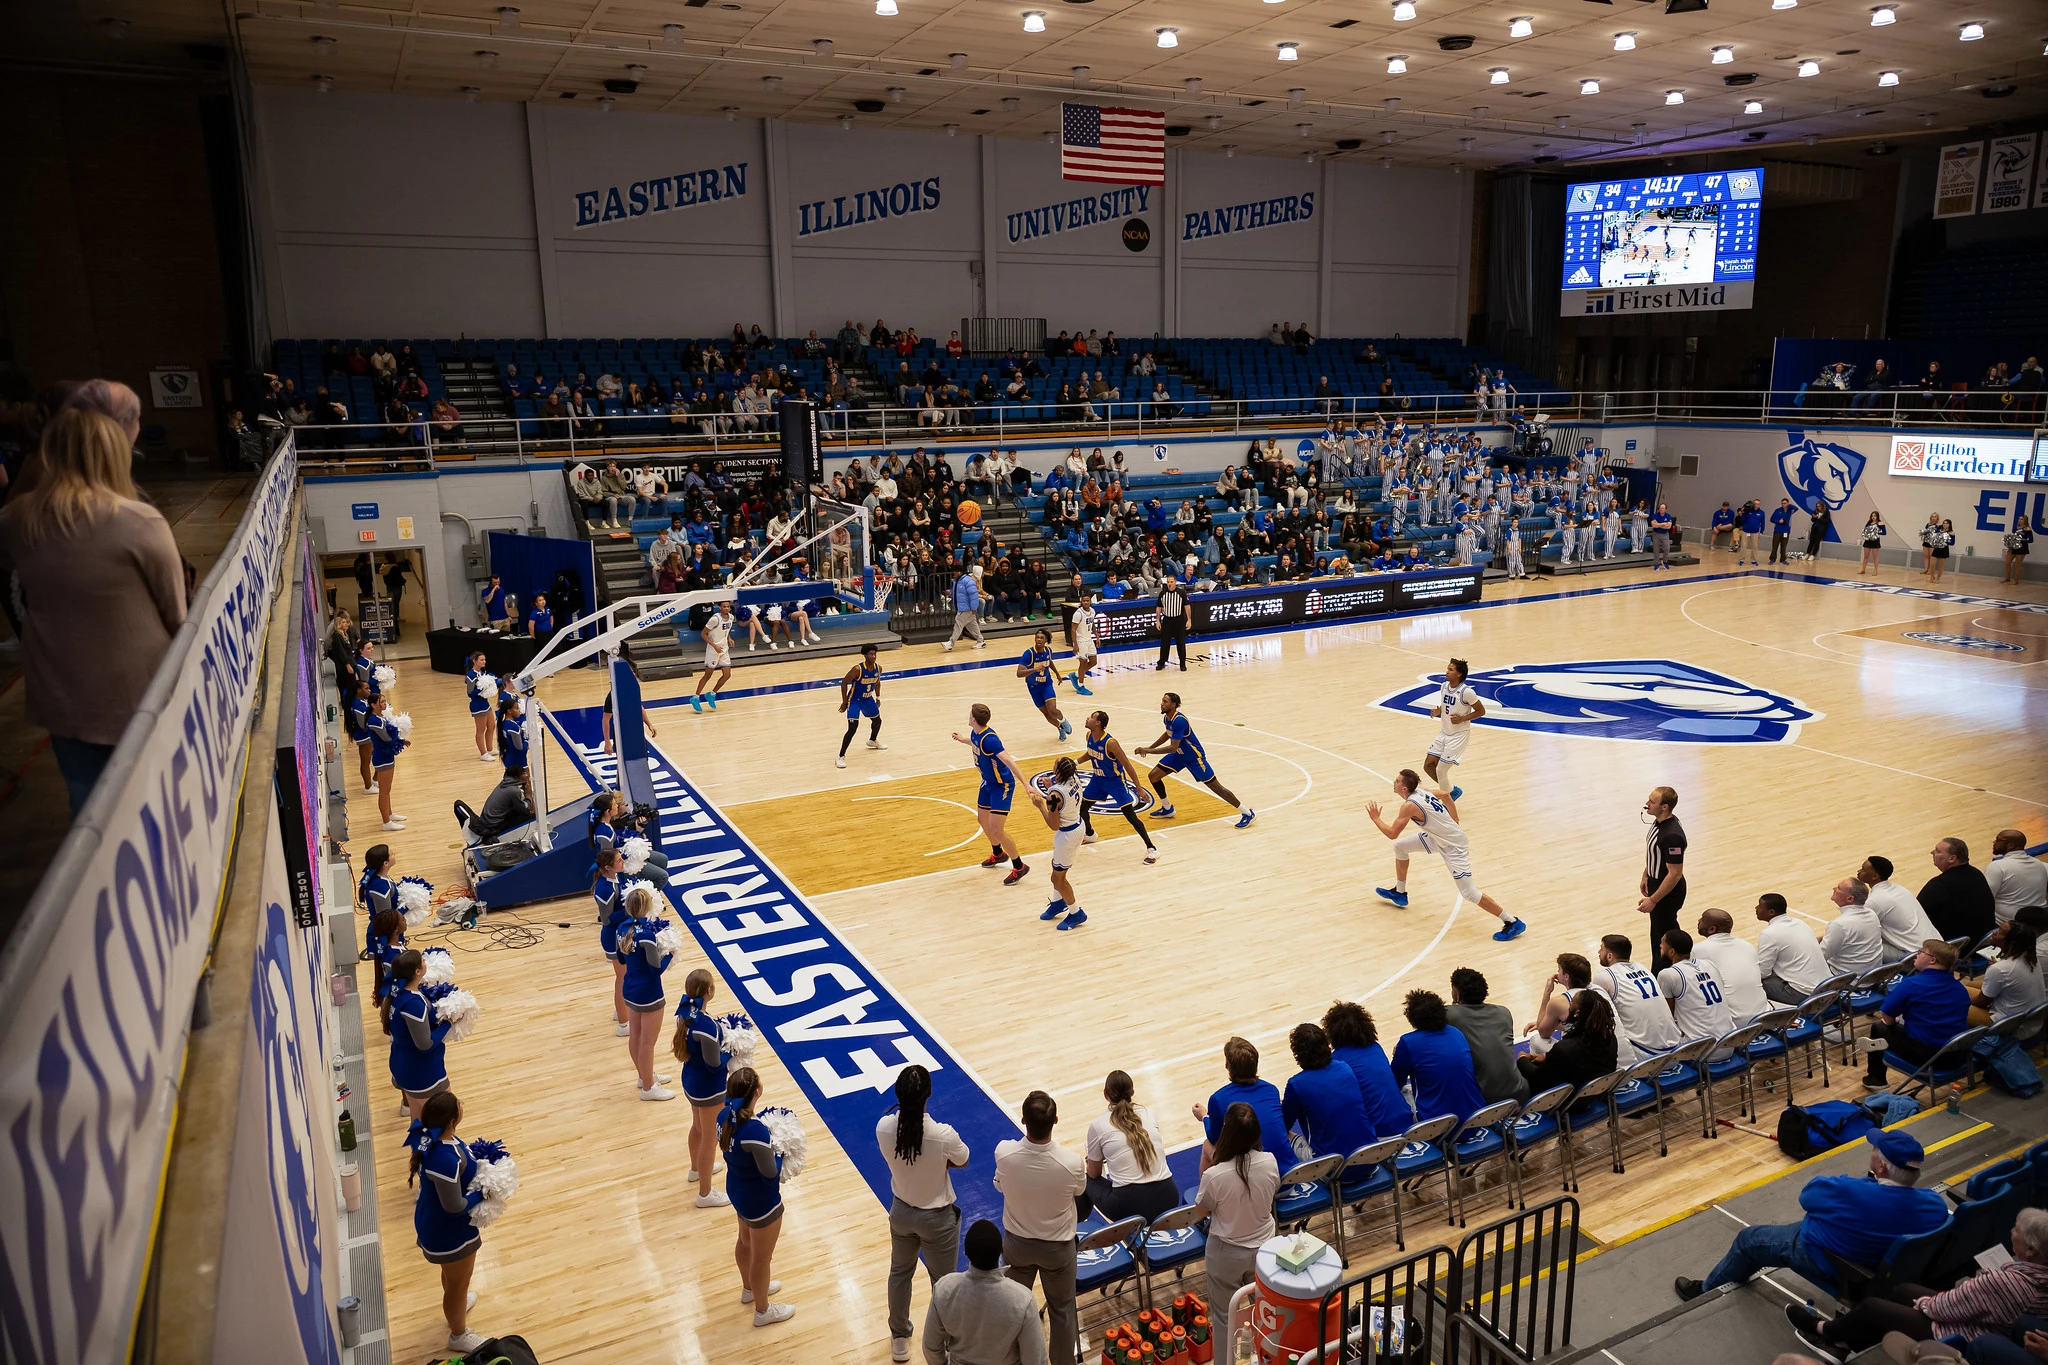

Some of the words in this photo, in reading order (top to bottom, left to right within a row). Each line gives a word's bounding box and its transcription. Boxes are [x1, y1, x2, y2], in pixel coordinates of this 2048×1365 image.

[1642, 176, 1684, 195] 14:17
[1704, 175, 1723, 188] 47
[1604, 183, 1621, 197] 34
[574, 162, 748, 230] EASTERN
[797, 176, 941, 238] ILLINOIS
[1006, 185, 1151, 244] UNIVERSITY
[1182, 191, 1315, 241] PANTHERS
[1646, 197, 1665, 207] HALF
[1990, 195, 2021, 209] 1980
[1123, 229, 1149, 240] NCAA
[1724, 262, 1754, 271] Lincoln
[1618, 290, 1673, 310] First
[1677, 285, 1726, 307] Mid
[1298, 449, 1315, 457] NCAA
[1929, 442, 1976, 457] Hilton
[1926, 455, 2005, 475] Garden
[1974, 489, 2048, 535] EIU
[362, 531, 375, 541] EXIT
[637, 606, 676, 629] Schelde
[1443, 694, 1457, 706] EIU
[1445, 706, 1450, 715] 5
[296, 871, 311, 926] FORMETCO
[666, 849, 943, 1098] EASTERN
[1634, 977, 1659, 999] 17
[1699, 981, 1722, 1006] 10
